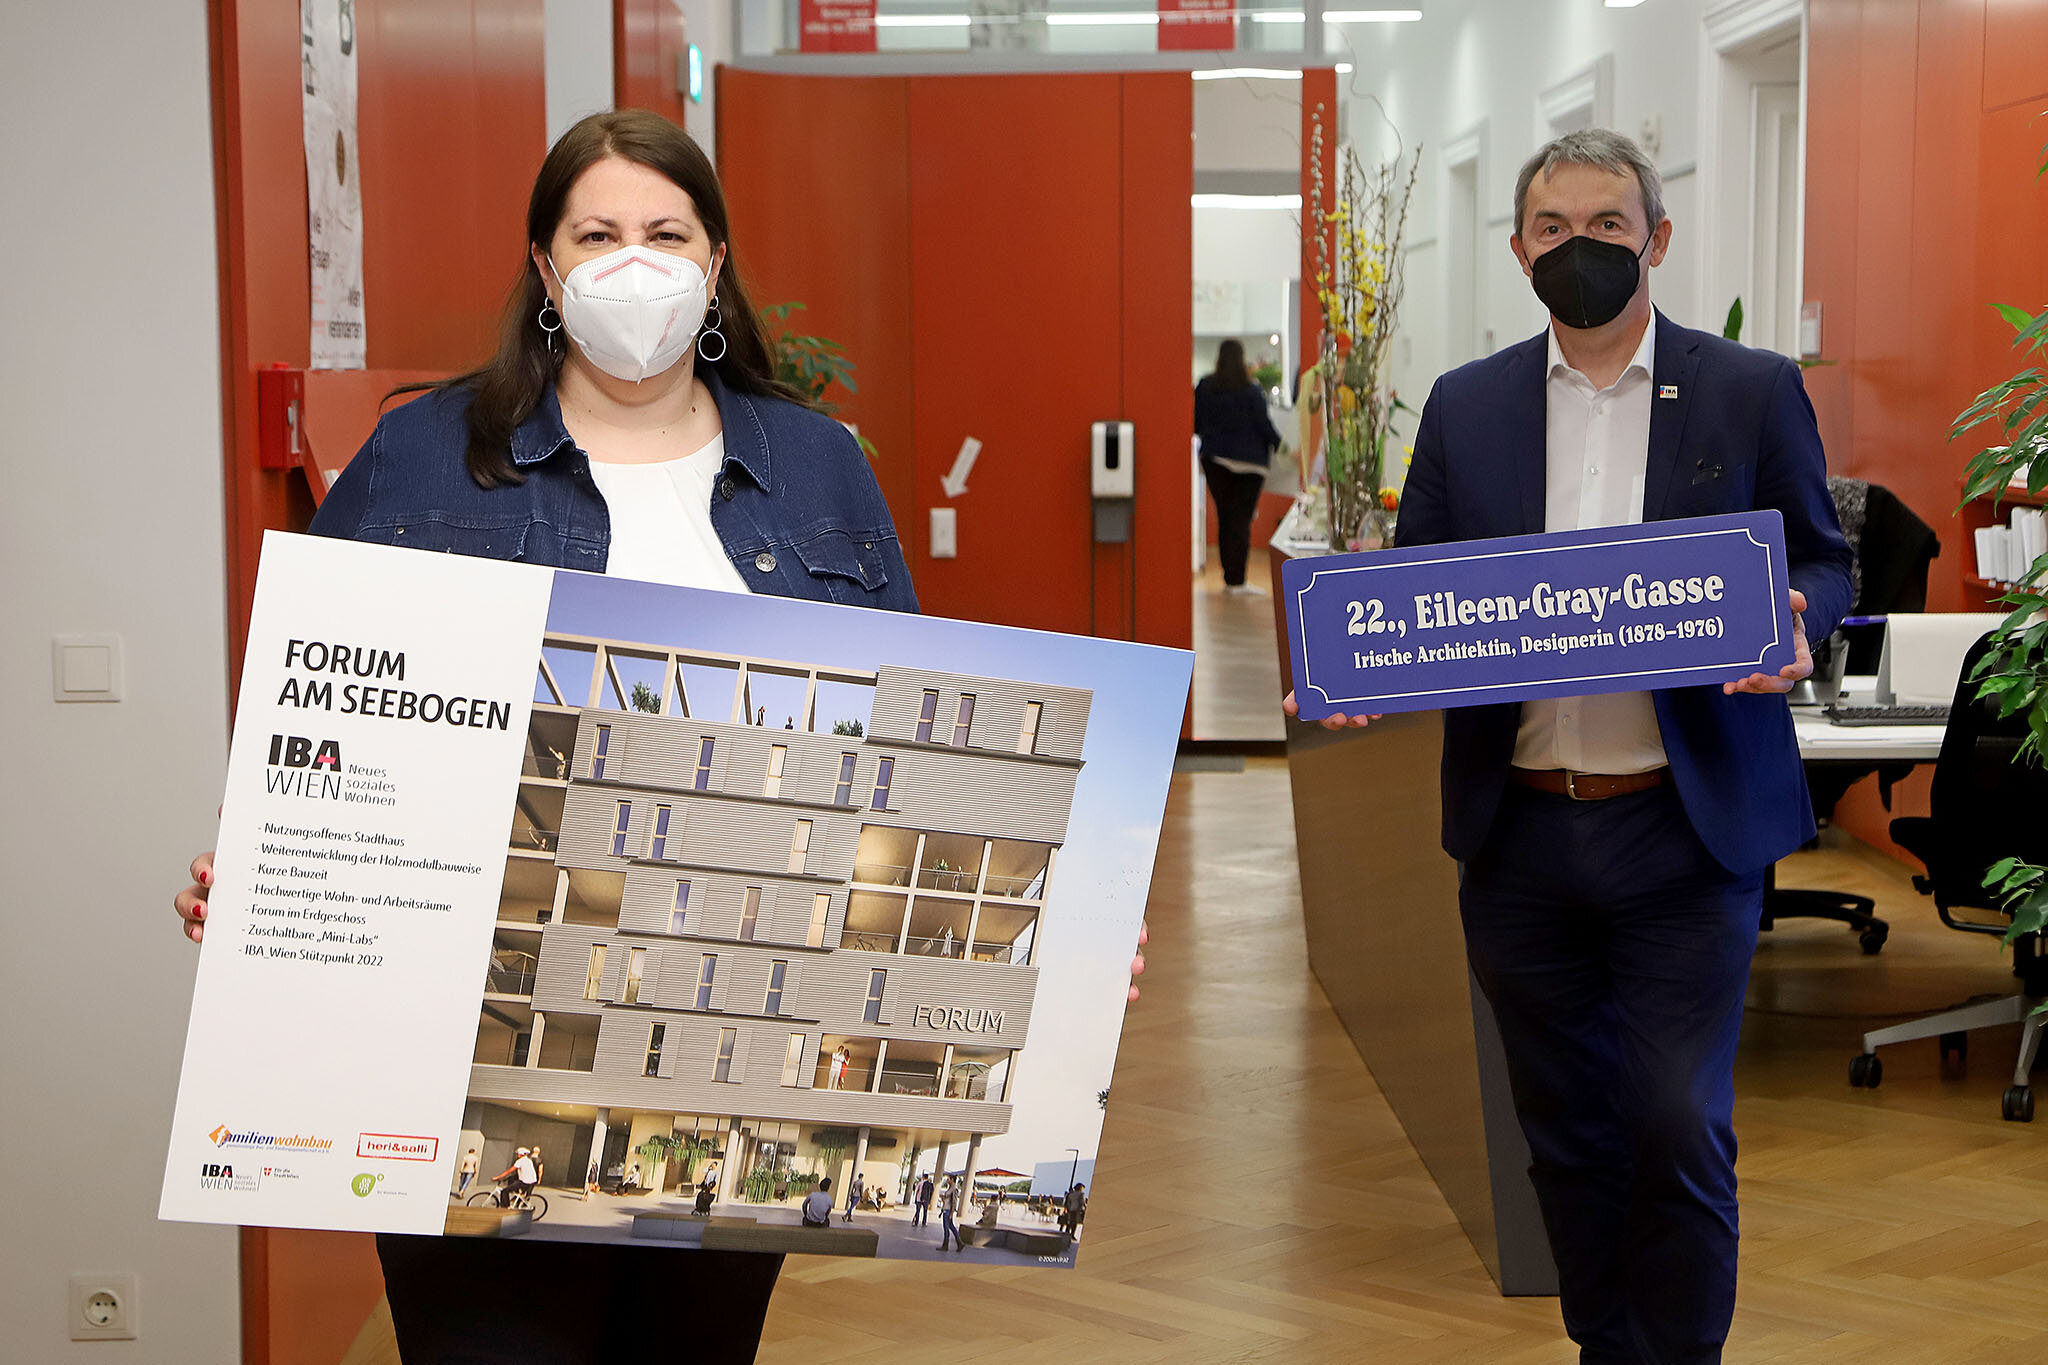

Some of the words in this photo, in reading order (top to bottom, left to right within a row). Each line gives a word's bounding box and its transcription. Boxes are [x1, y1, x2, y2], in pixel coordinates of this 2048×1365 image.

[1346, 598, 1408, 638] 22.,
[1414, 573, 1725, 630] Eileen-Gray-Gasse
[285, 639, 405, 681] FORUM
[1354, 647, 1413, 669] Irische
[1416, 637, 1517, 664] Architektin,
[1520, 628, 1615, 655] Designerin
[277, 678, 332, 711] AM
[340, 684, 512, 731] SEEBOGEN
[268, 734, 342, 772] IBA
[348, 764, 387, 778] Neues
[266, 768, 342, 801] WIEN
[346, 779, 396, 793] soziales
[344, 791, 396, 807] Wohnen
[264, 822, 352, 841] Nutzungsoffenes
[354, 831, 406, 848] Stadthaus
[261, 842, 358, 866] Weiterentwicklung
[360, 852, 378, 865] der
[379, 854, 482, 875] Holzmodulbauweise
[258, 863, 288, 877] Kurze
[290, 866, 328, 880] Bauzeit
[254, 883, 322, 903] Hochwertige
[324, 889, 359, 904] Wohn-
[361, 894, 382, 906] und
[382, 895, 452, 912] Arbeitsräume
[251, 903, 285, 918] Forum
[287, 907, 301, 919] im
[302, 908, 366, 925] Erdgeschoss
[248, 923, 315, 941] Zuschaltbare
[245, 944, 297, 960] IBA_Wien
[299, 949, 355, 966] Stützpunkt
[356, 953, 384, 967] 2022
[913, 1003, 1005, 1034] FORUM
[366, 1140, 428, 1154] heri&salli
[202, 1163, 233, 1178] IBA
[201, 1178, 233, 1191] WIEN
